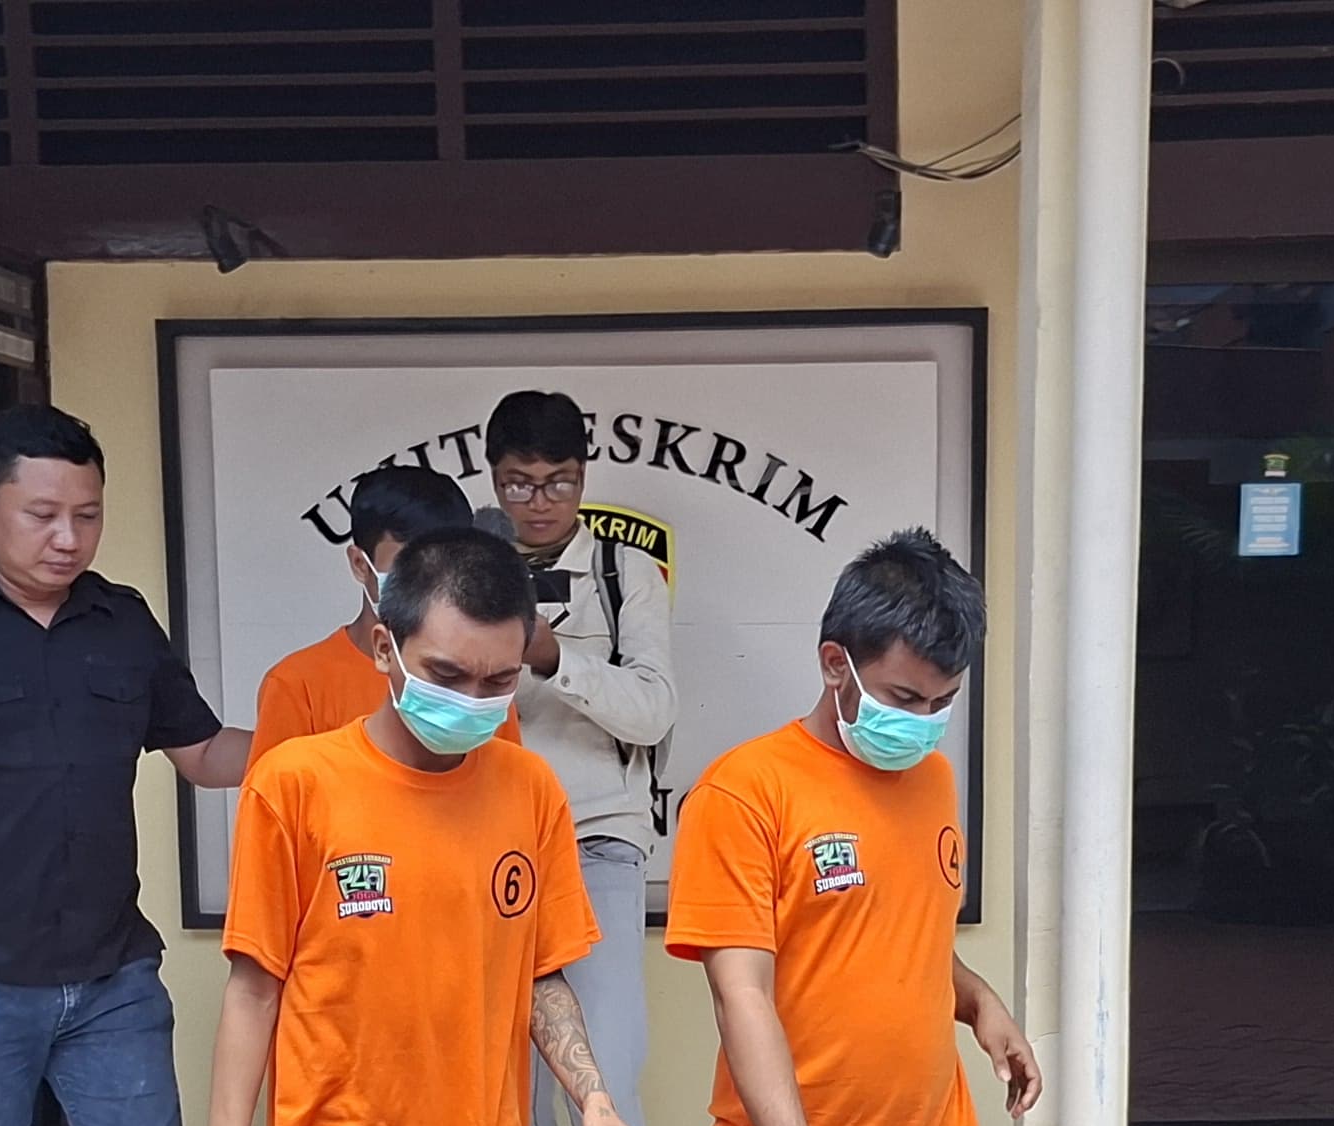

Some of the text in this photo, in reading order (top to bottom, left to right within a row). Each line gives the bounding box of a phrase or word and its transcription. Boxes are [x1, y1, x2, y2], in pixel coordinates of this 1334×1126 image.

[301, 411, 848, 545] UIT ESKRIM
[576, 513, 659, 550] KRIM
[949, 839, 960, 878] 4
[504, 865, 522, 906] 6
